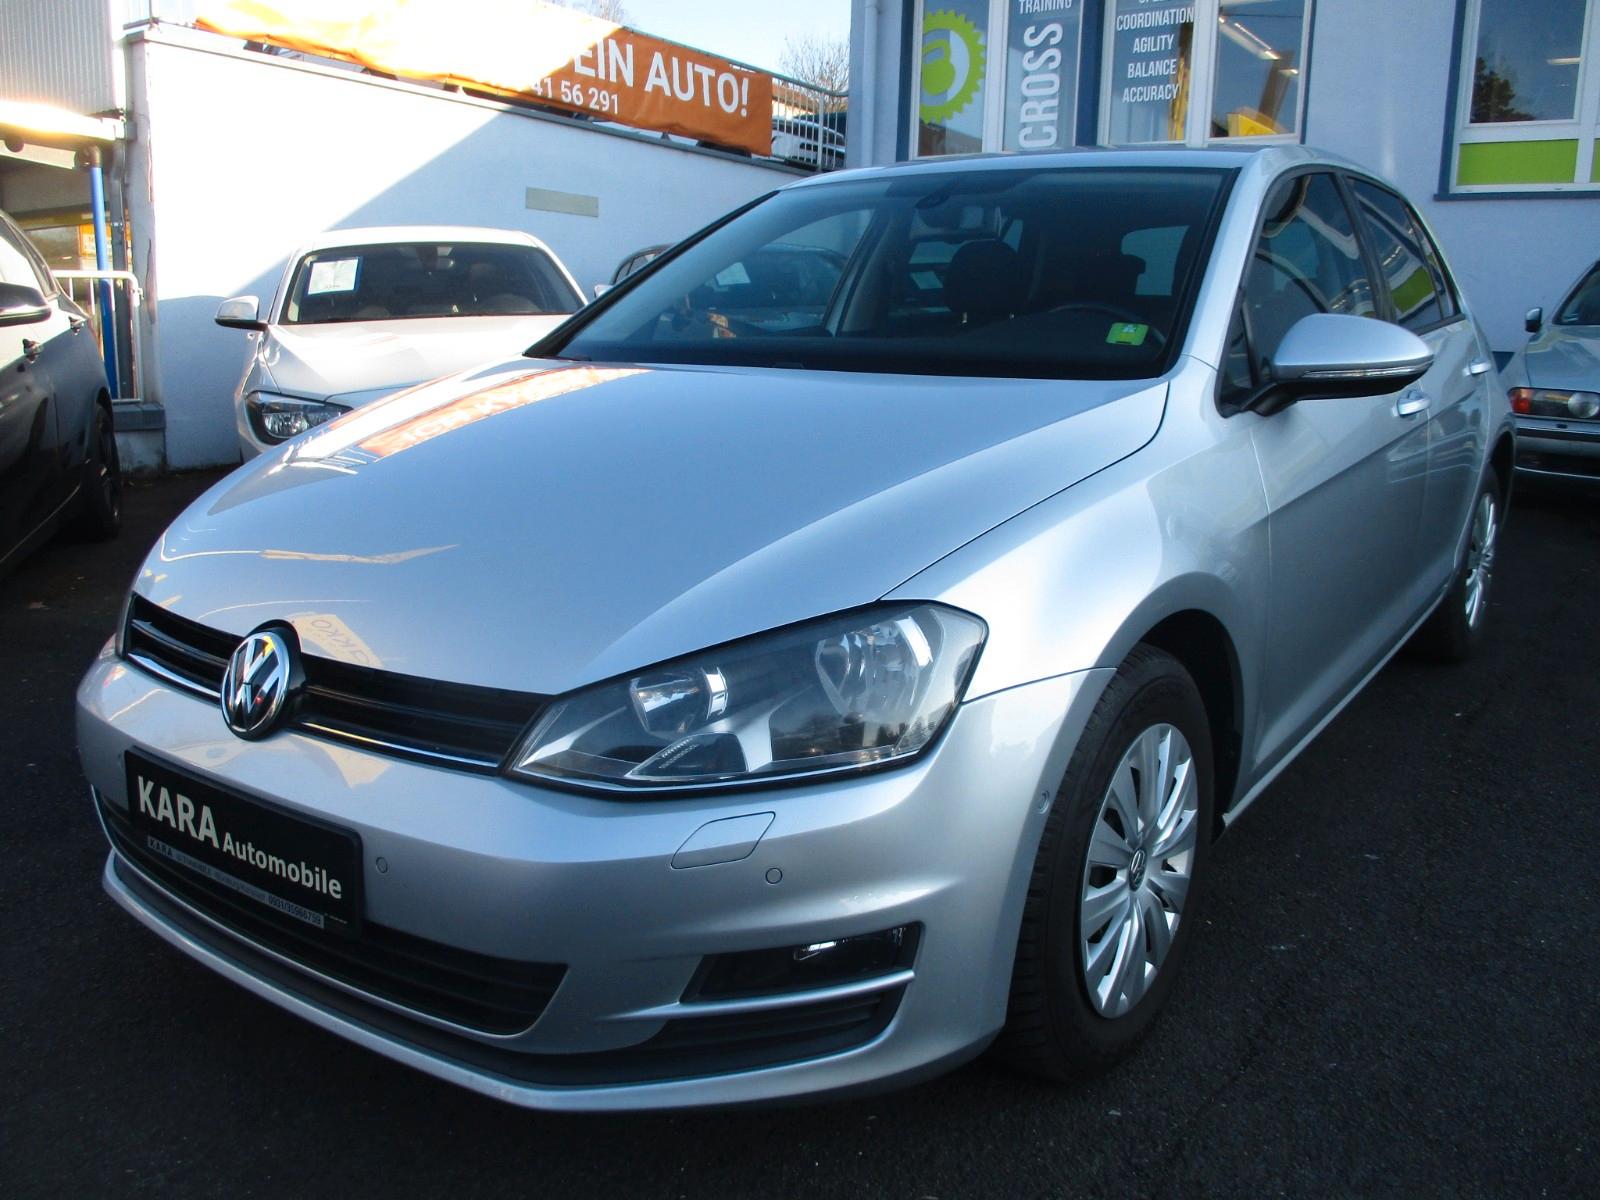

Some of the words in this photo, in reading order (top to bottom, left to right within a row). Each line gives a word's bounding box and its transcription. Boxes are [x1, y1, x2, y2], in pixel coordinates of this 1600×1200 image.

[1116, 7, 1195, 31] COORDINATION
[1132, 34, 1174, 54] AGILITY
[1127, 59, 1177, 78] BALANCE
[561, 79, 584, 106] 56
[588, 87, 619, 115] 291
[644, 51, 749, 117] AUTO!
[1019, 23, 1063, 150] CROSS
[1122, 84, 1180, 103] ACCURACY
[138, 776, 220, 848] KARA
[222, 832, 342, 899] Automobile
